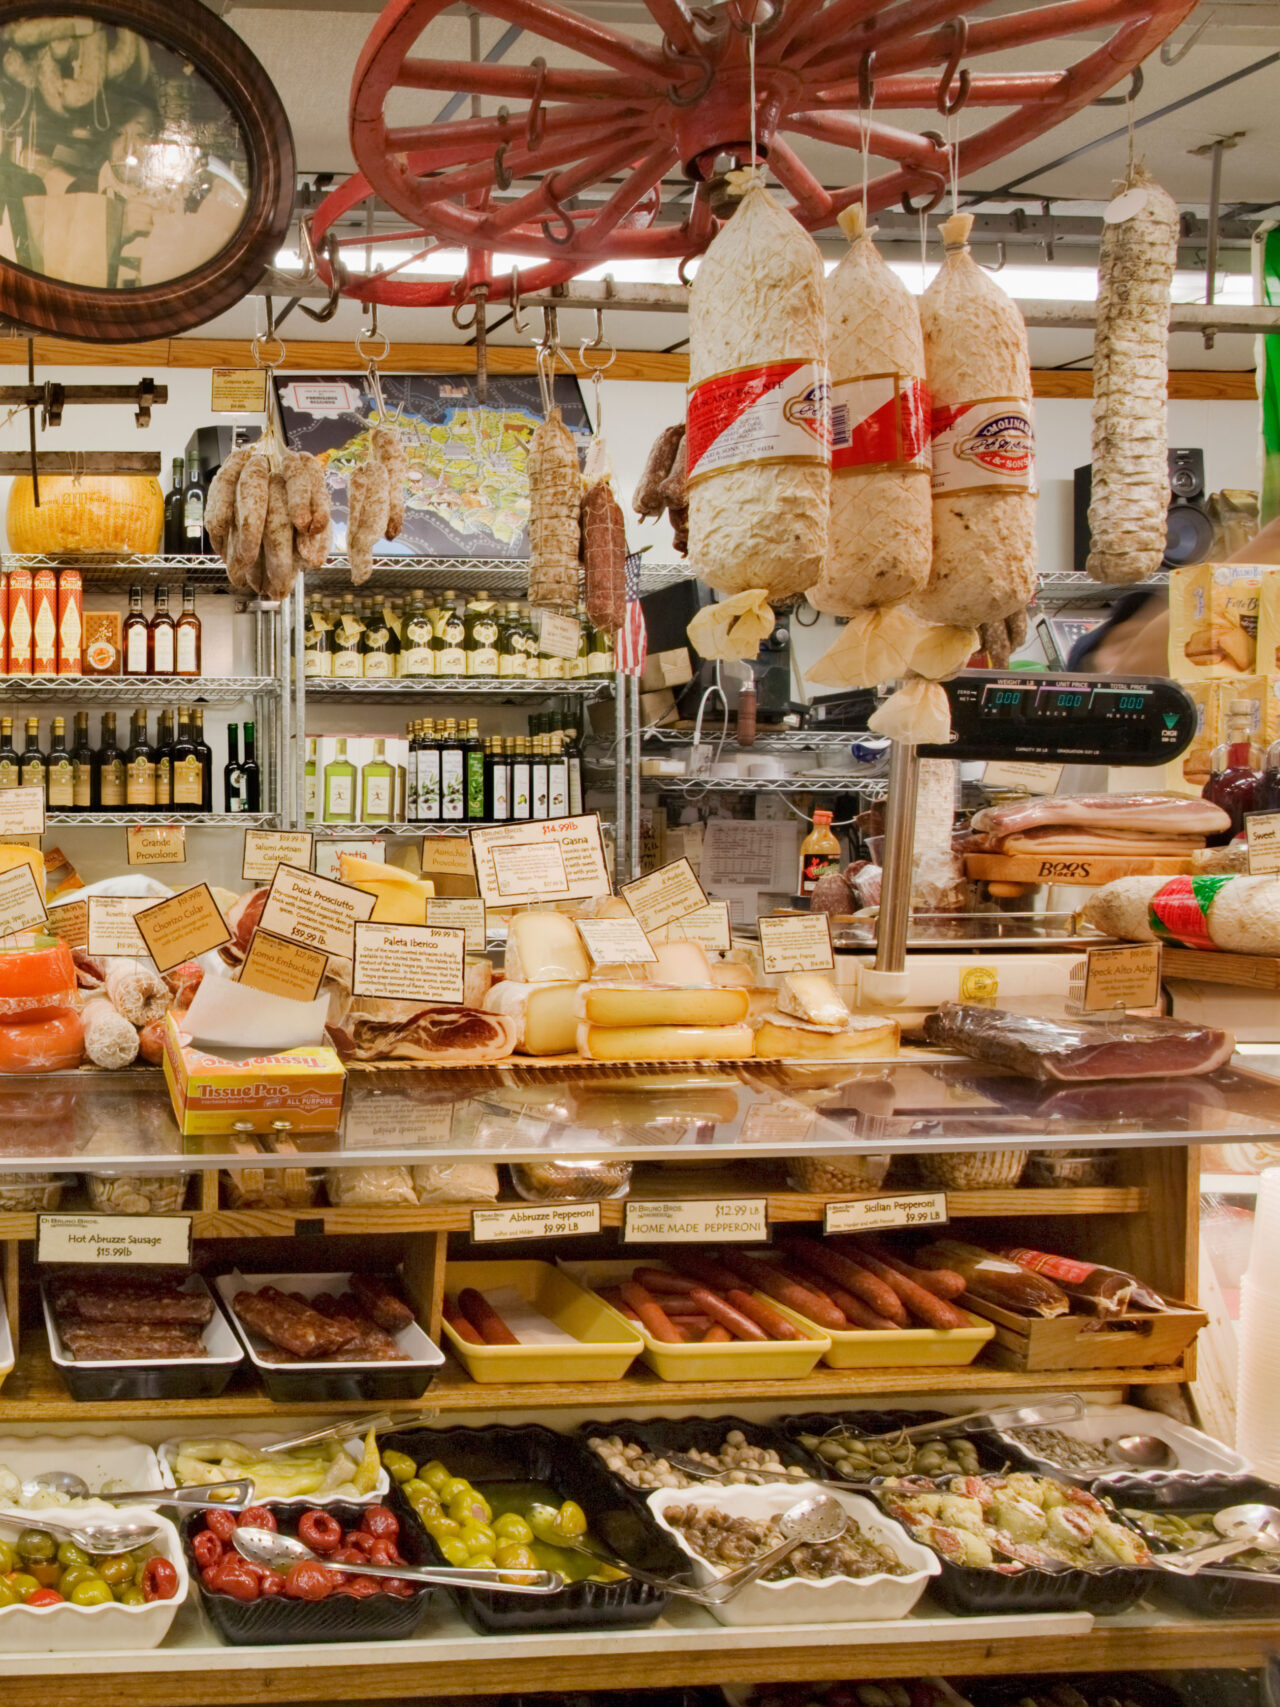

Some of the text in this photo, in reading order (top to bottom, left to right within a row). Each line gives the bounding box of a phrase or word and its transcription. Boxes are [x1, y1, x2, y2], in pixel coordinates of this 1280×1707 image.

[1037, 861, 1091, 878] BOOS
[715, 1205, 747, 1218] $12.99
[749, 1207, 760, 1215] LB
[893, 1199, 936, 1211] Pepperoni
[508, 1208, 595, 1223] Abbruzze Pepperoni
[905, 1211, 940, 1224] $9.99 LB
[543, 1223, 579, 1234] $9.99 LB
[631, 1222, 761, 1233] HOME MADE PEPPERONI
[68, 1234, 162, 1247] Hot Abruzze Sausage
[96, 1246, 133, 1257] $15.99lb
